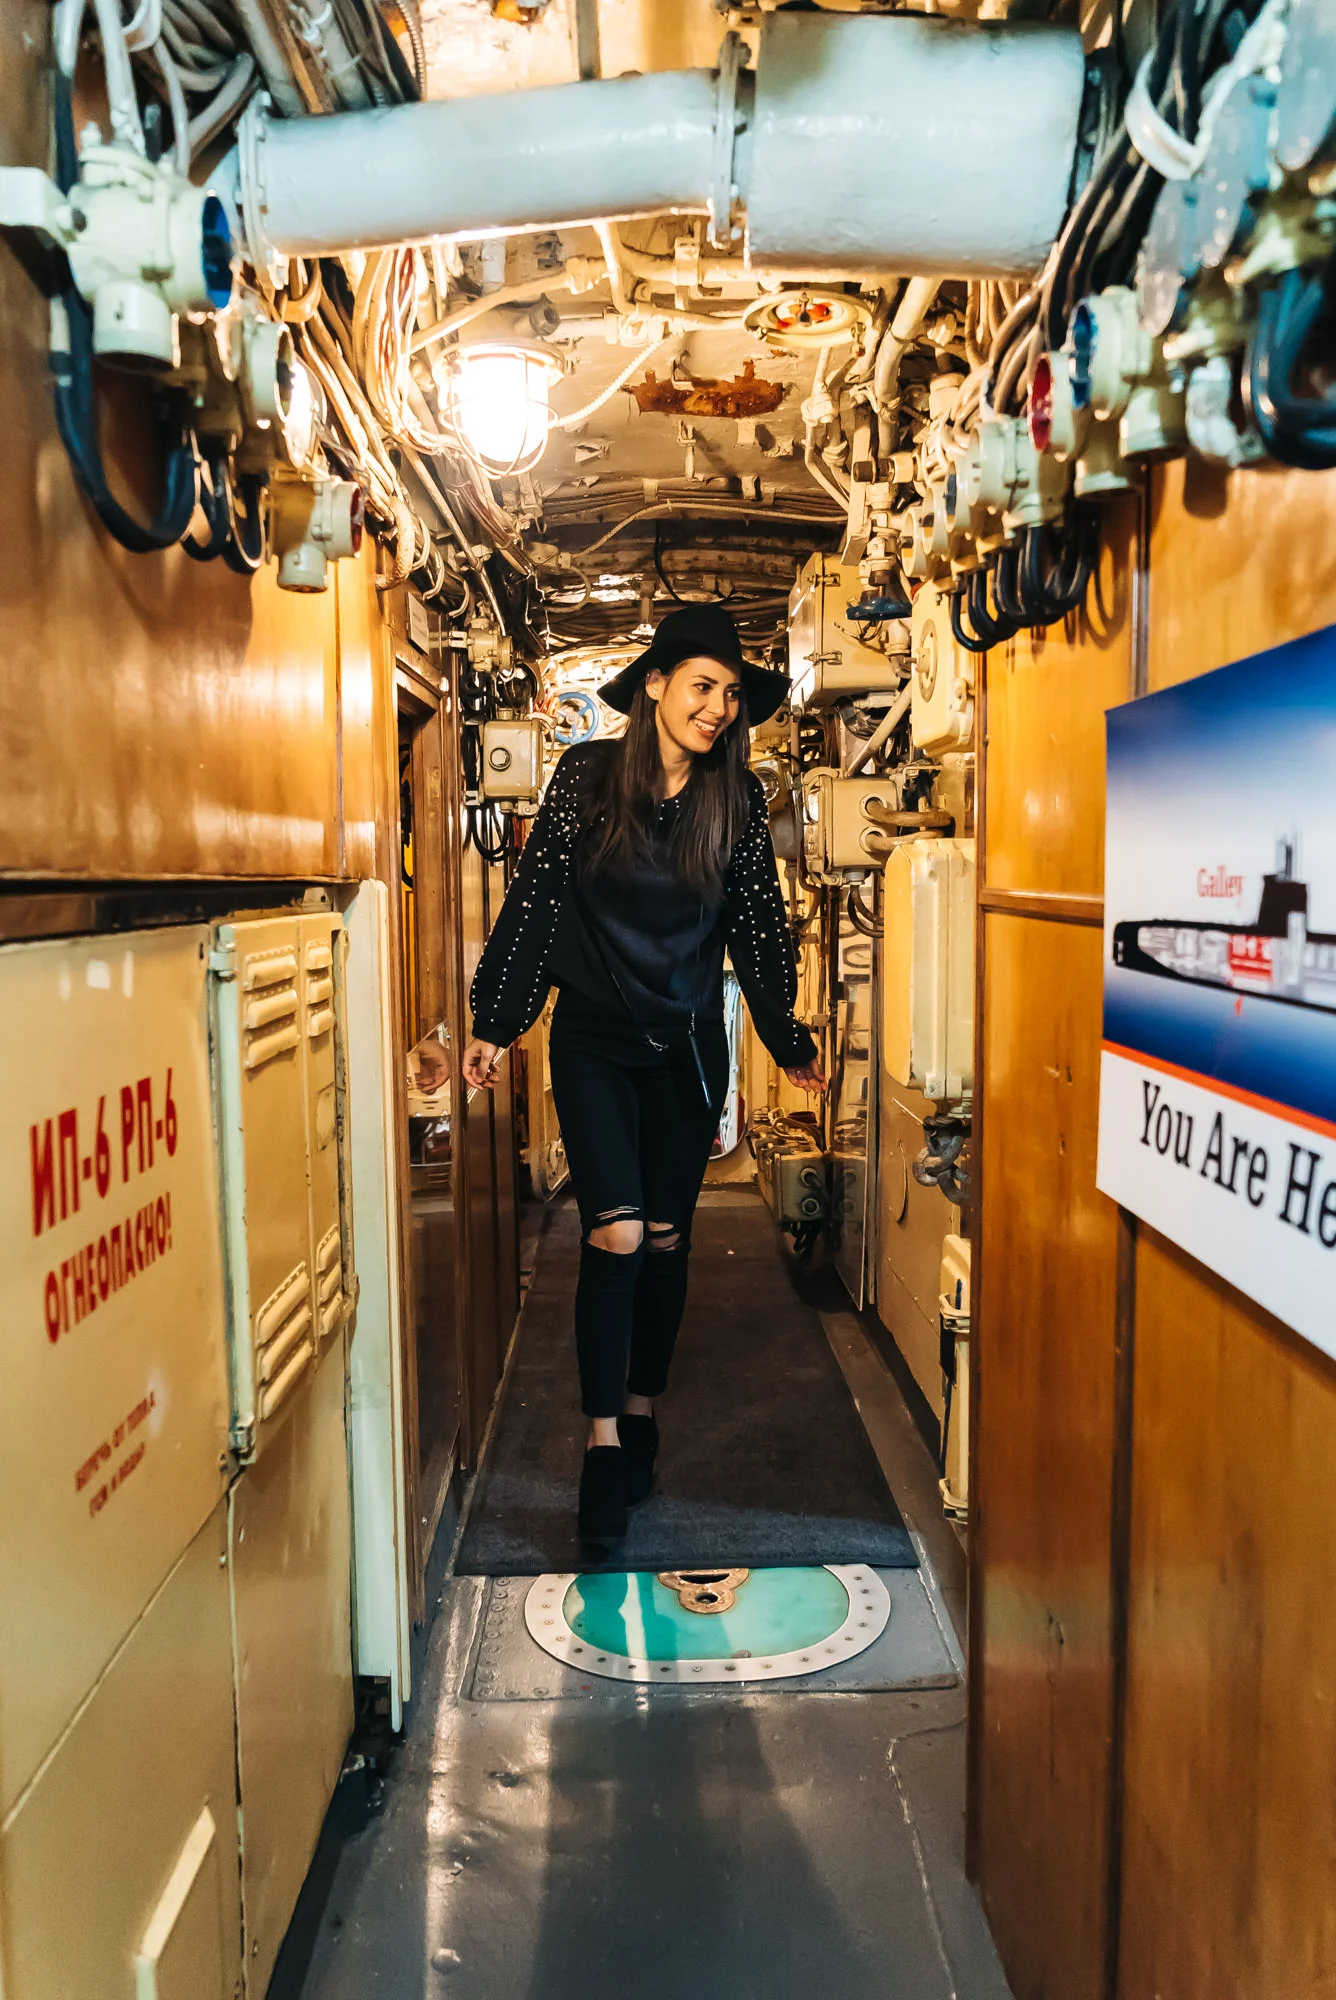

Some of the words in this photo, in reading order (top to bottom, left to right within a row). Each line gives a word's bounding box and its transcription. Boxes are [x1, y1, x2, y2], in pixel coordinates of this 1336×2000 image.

[1197, 865, 1243, 908] Galley
[30, 1095, 111, 1238] ИП-6
[120, 1067, 177, 1184] РП-6
[1140, 1080, 1193, 1169] You
[1199, 1111, 1268, 1207] Are
[44, 1191, 172, 1344] ОГНЕОПАСНО!
